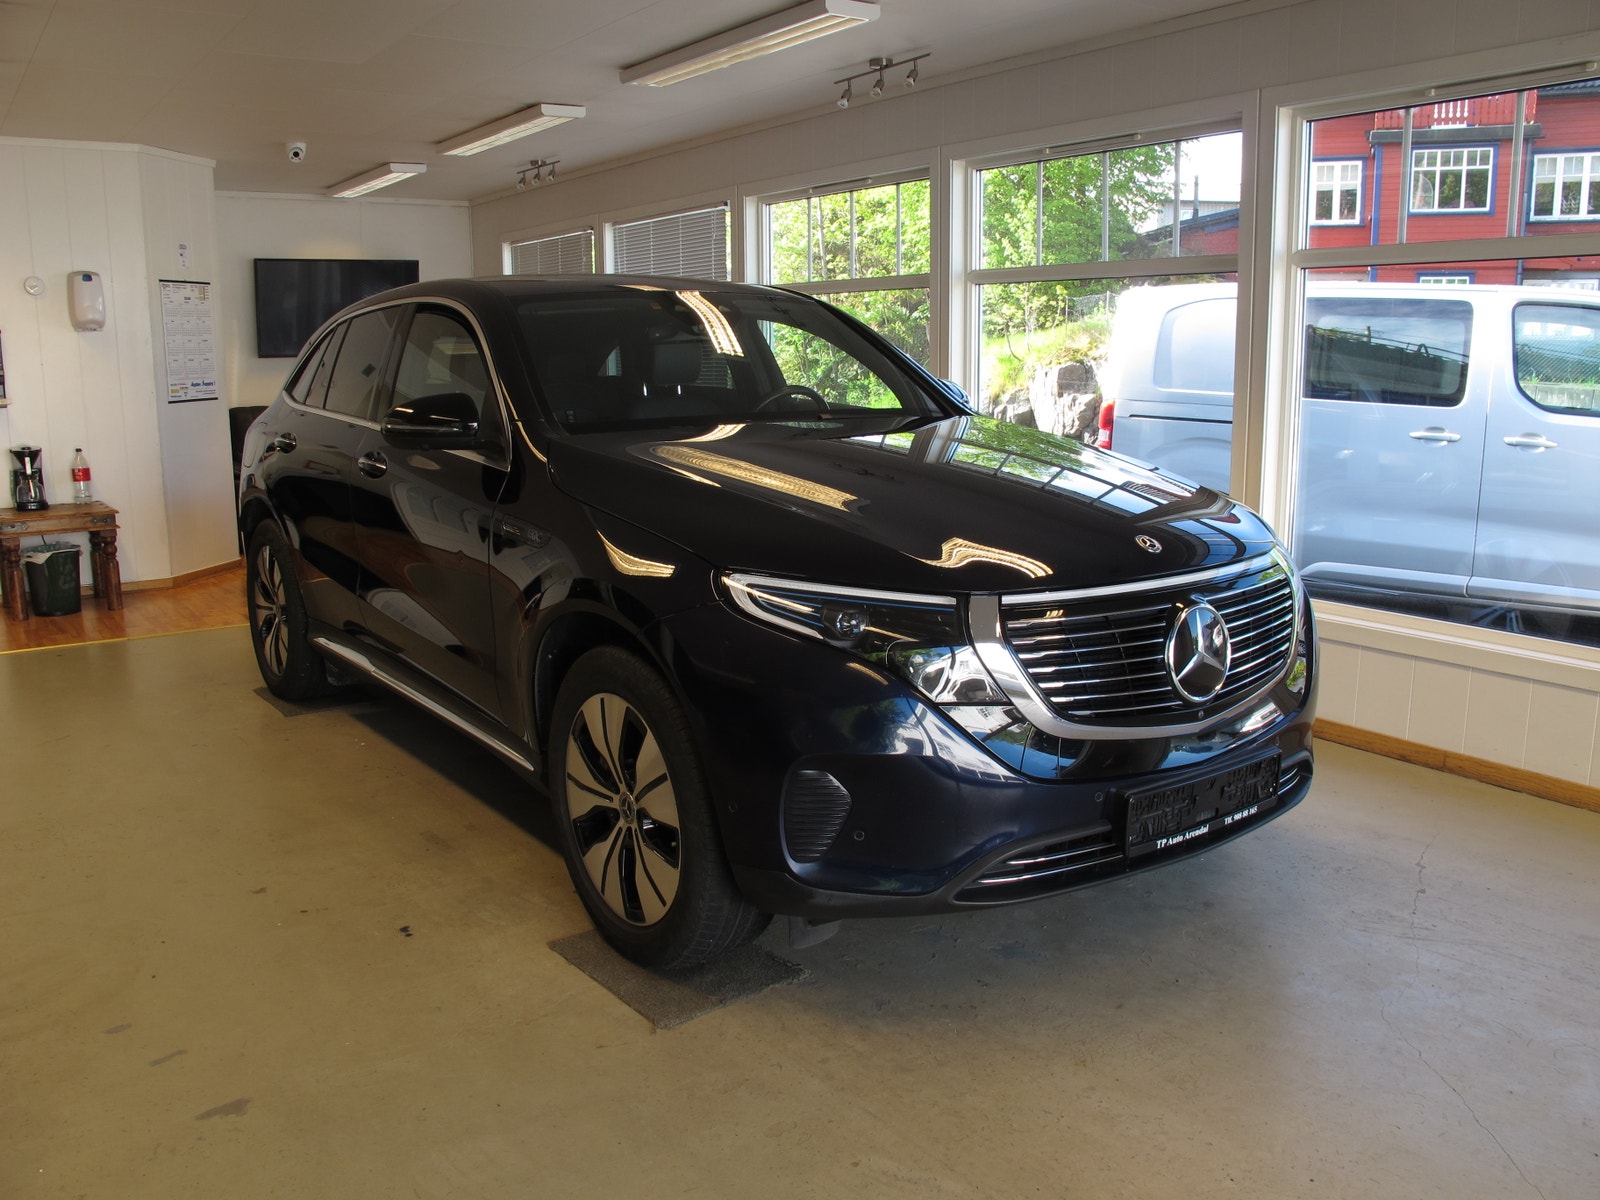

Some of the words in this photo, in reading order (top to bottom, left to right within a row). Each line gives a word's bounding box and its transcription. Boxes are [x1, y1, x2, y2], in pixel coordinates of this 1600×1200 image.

[1156, 838, 1167, 849] TP
[1166, 835, 1183, 846] Auto
[1183, 824, 1209, 840] Arendal
